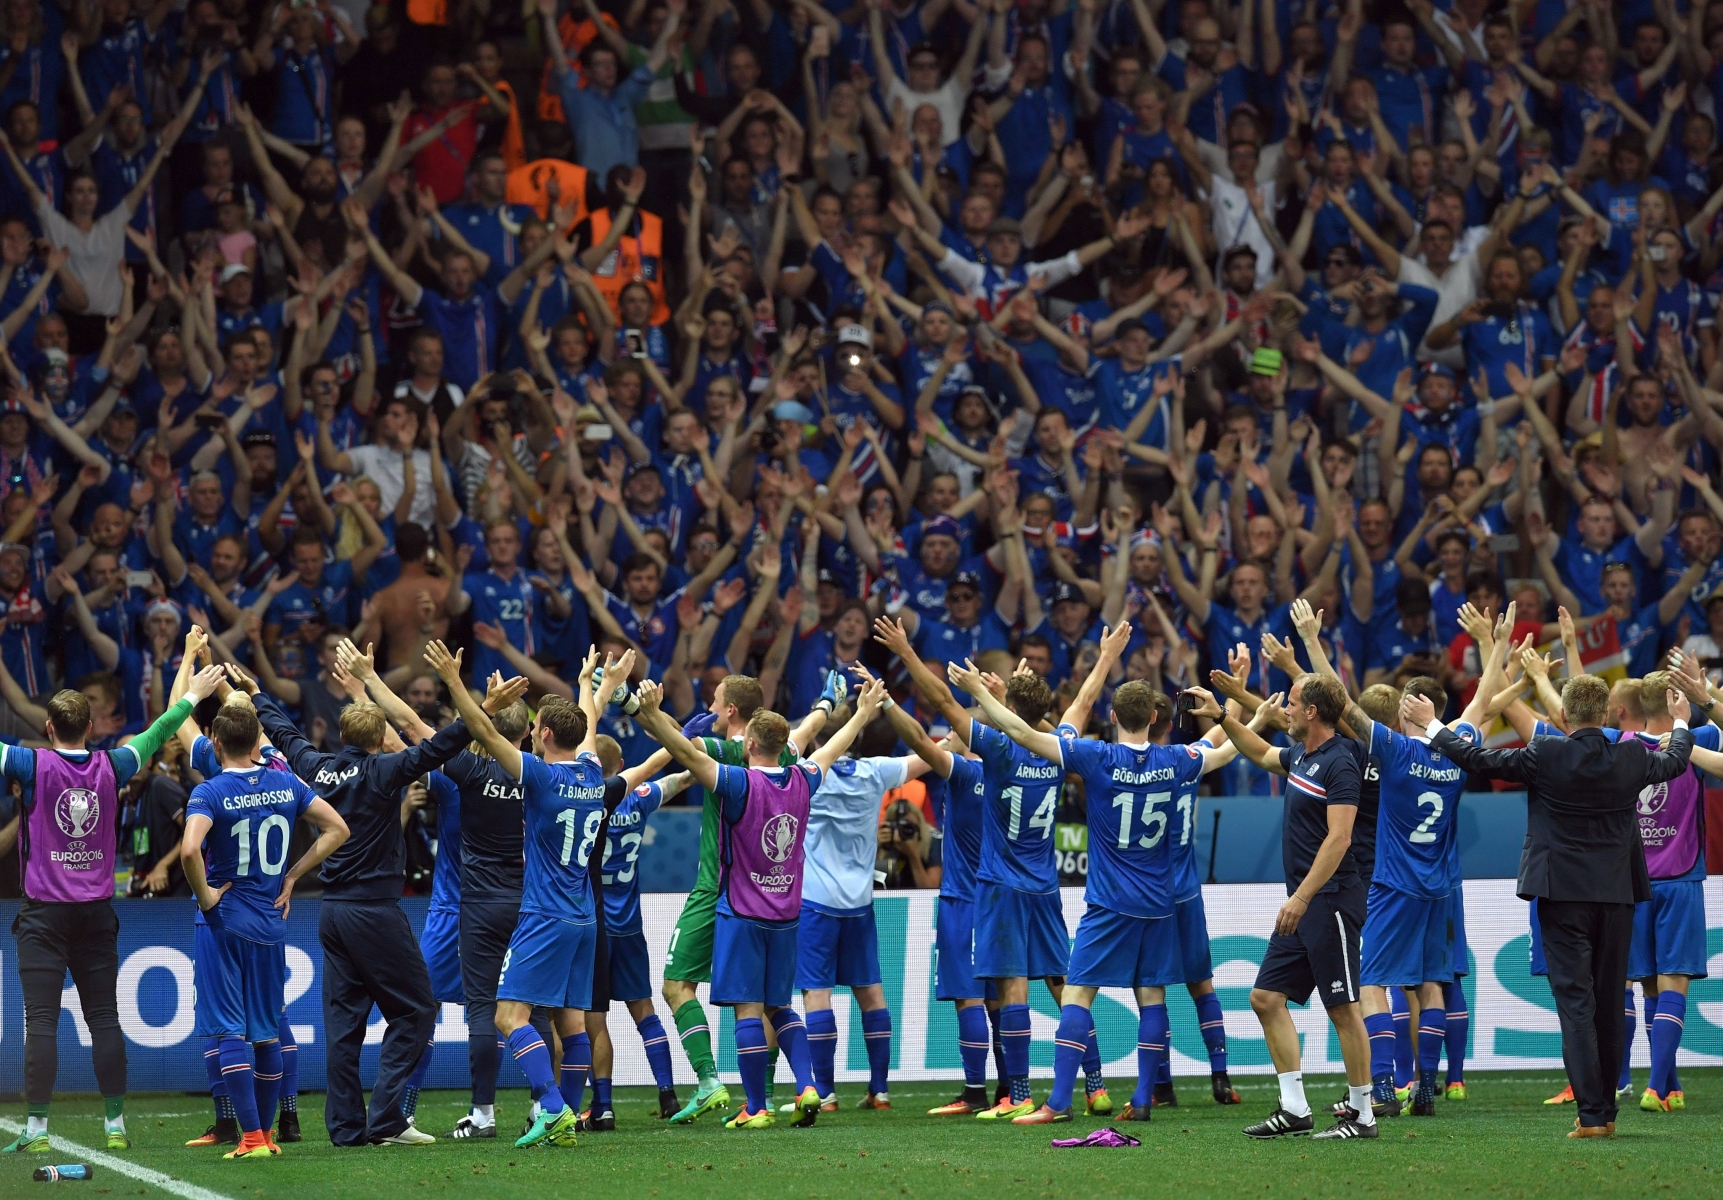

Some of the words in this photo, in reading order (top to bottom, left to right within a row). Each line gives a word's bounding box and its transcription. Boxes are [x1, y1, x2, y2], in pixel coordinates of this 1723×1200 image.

[499, 599, 524, 620] 22
[1015, 762, 1058, 779] ÁRNASON
[223, 788, 295, 811] G.SIGURÐSSON
[1001, 786, 1057, 840] 14
[1112, 791, 1172, 849] 15
[1409, 791, 1443, 843] 2
[67, 840, 88, 852] UEFA
[230, 814, 290, 876] 10
[555, 808, 603, 867] 18
[1060, 826, 1085, 848] TV
[63, 862, 91, 870] FRANCE
